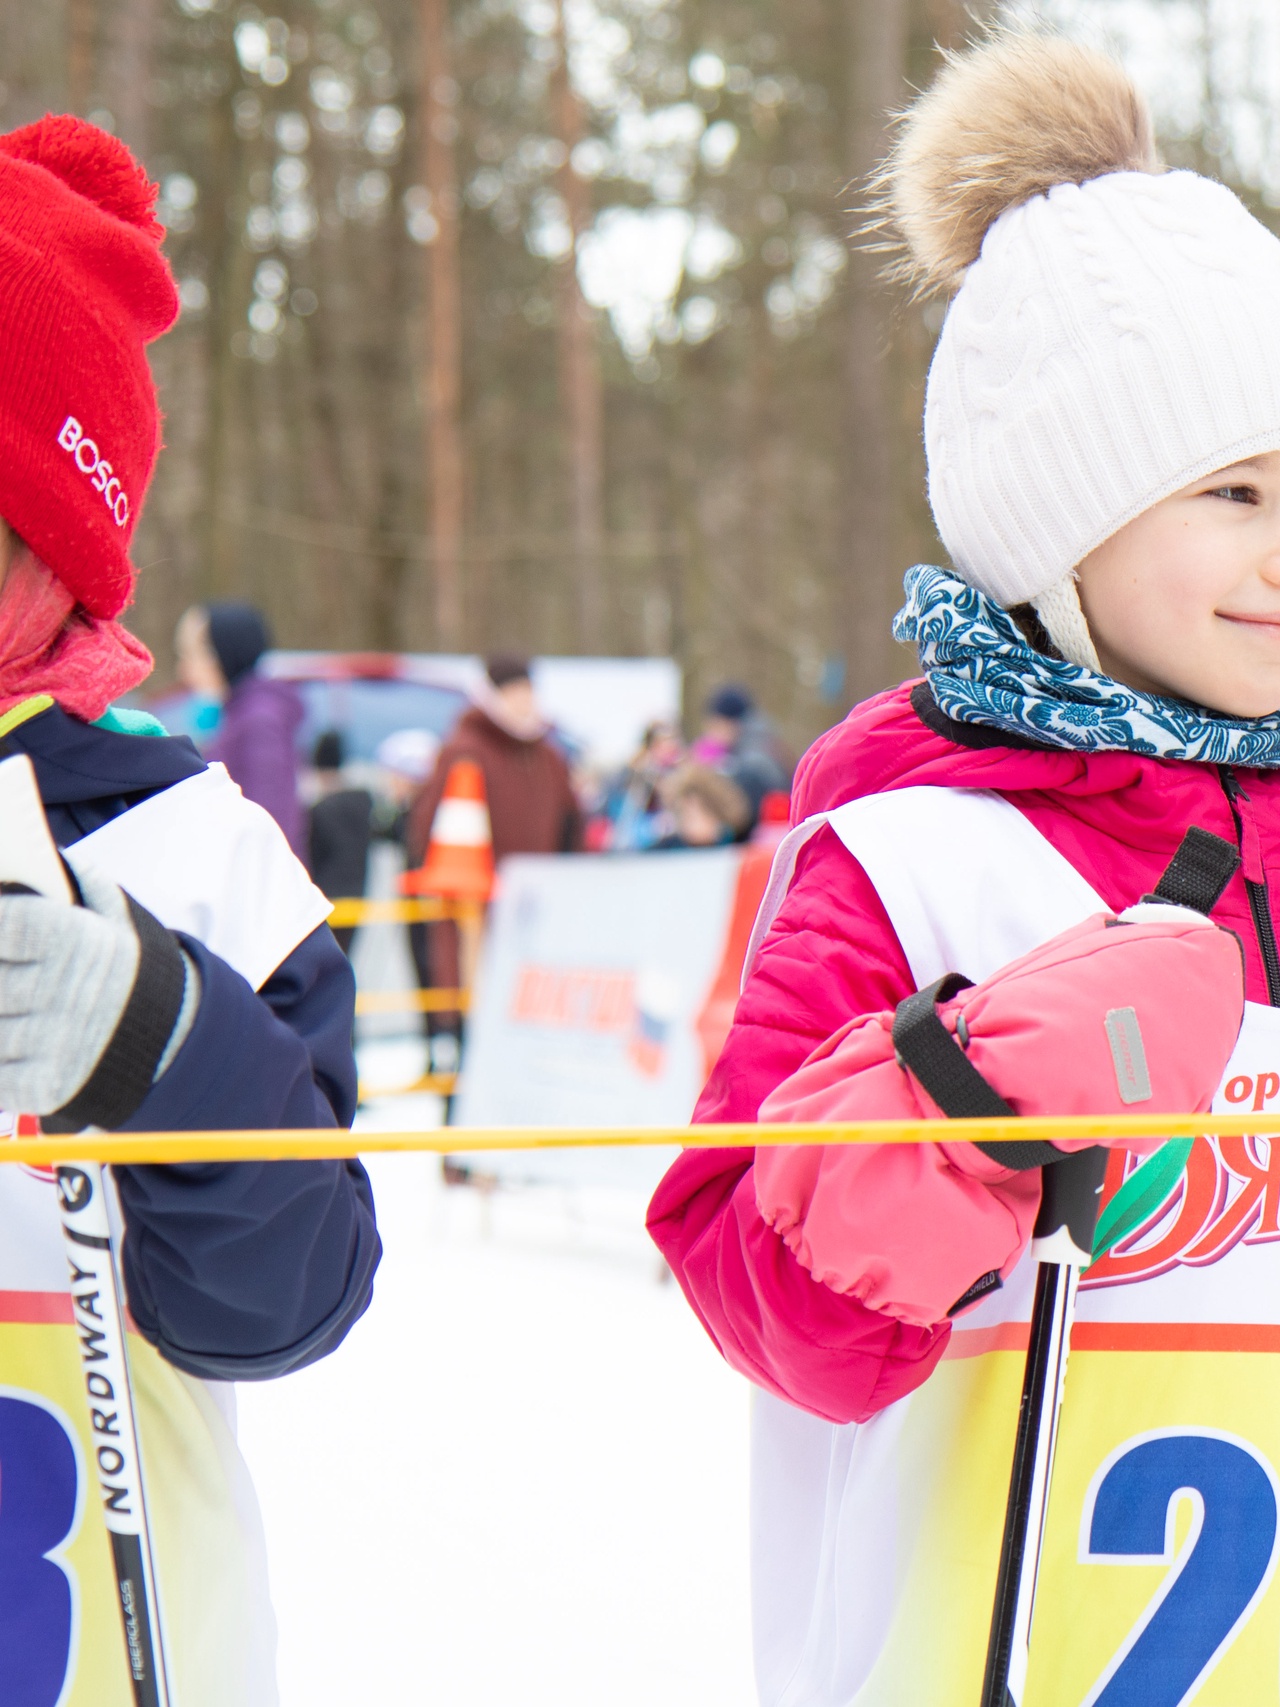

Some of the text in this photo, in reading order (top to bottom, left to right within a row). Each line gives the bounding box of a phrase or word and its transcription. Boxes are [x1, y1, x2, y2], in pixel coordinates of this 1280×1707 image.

[57, 415, 128, 528] BOSCO
[68, 1256, 131, 1515] NORDWAY
[119, 1579, 145, 1681] FIBERGLASS
